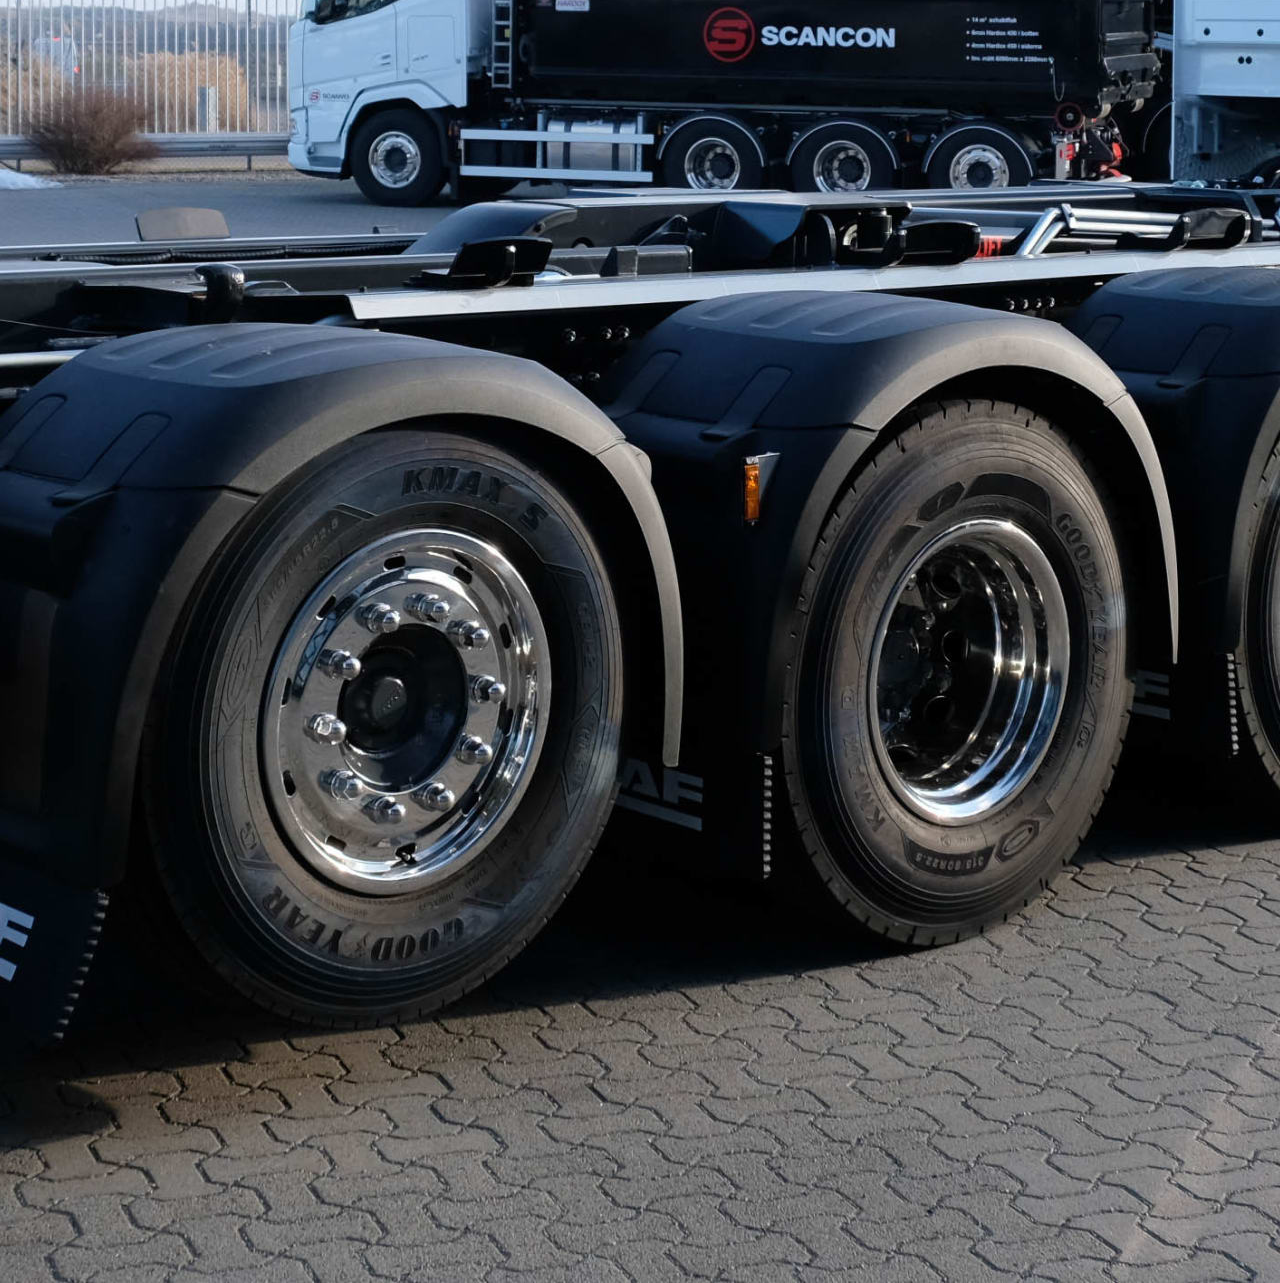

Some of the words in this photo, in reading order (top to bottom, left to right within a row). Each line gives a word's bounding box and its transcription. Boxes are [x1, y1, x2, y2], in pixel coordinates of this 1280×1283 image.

[760, 25, 896, 49] SCANCON
[401, 465, 508, 504] KMAX
[620, 758, 705, 804] AF
